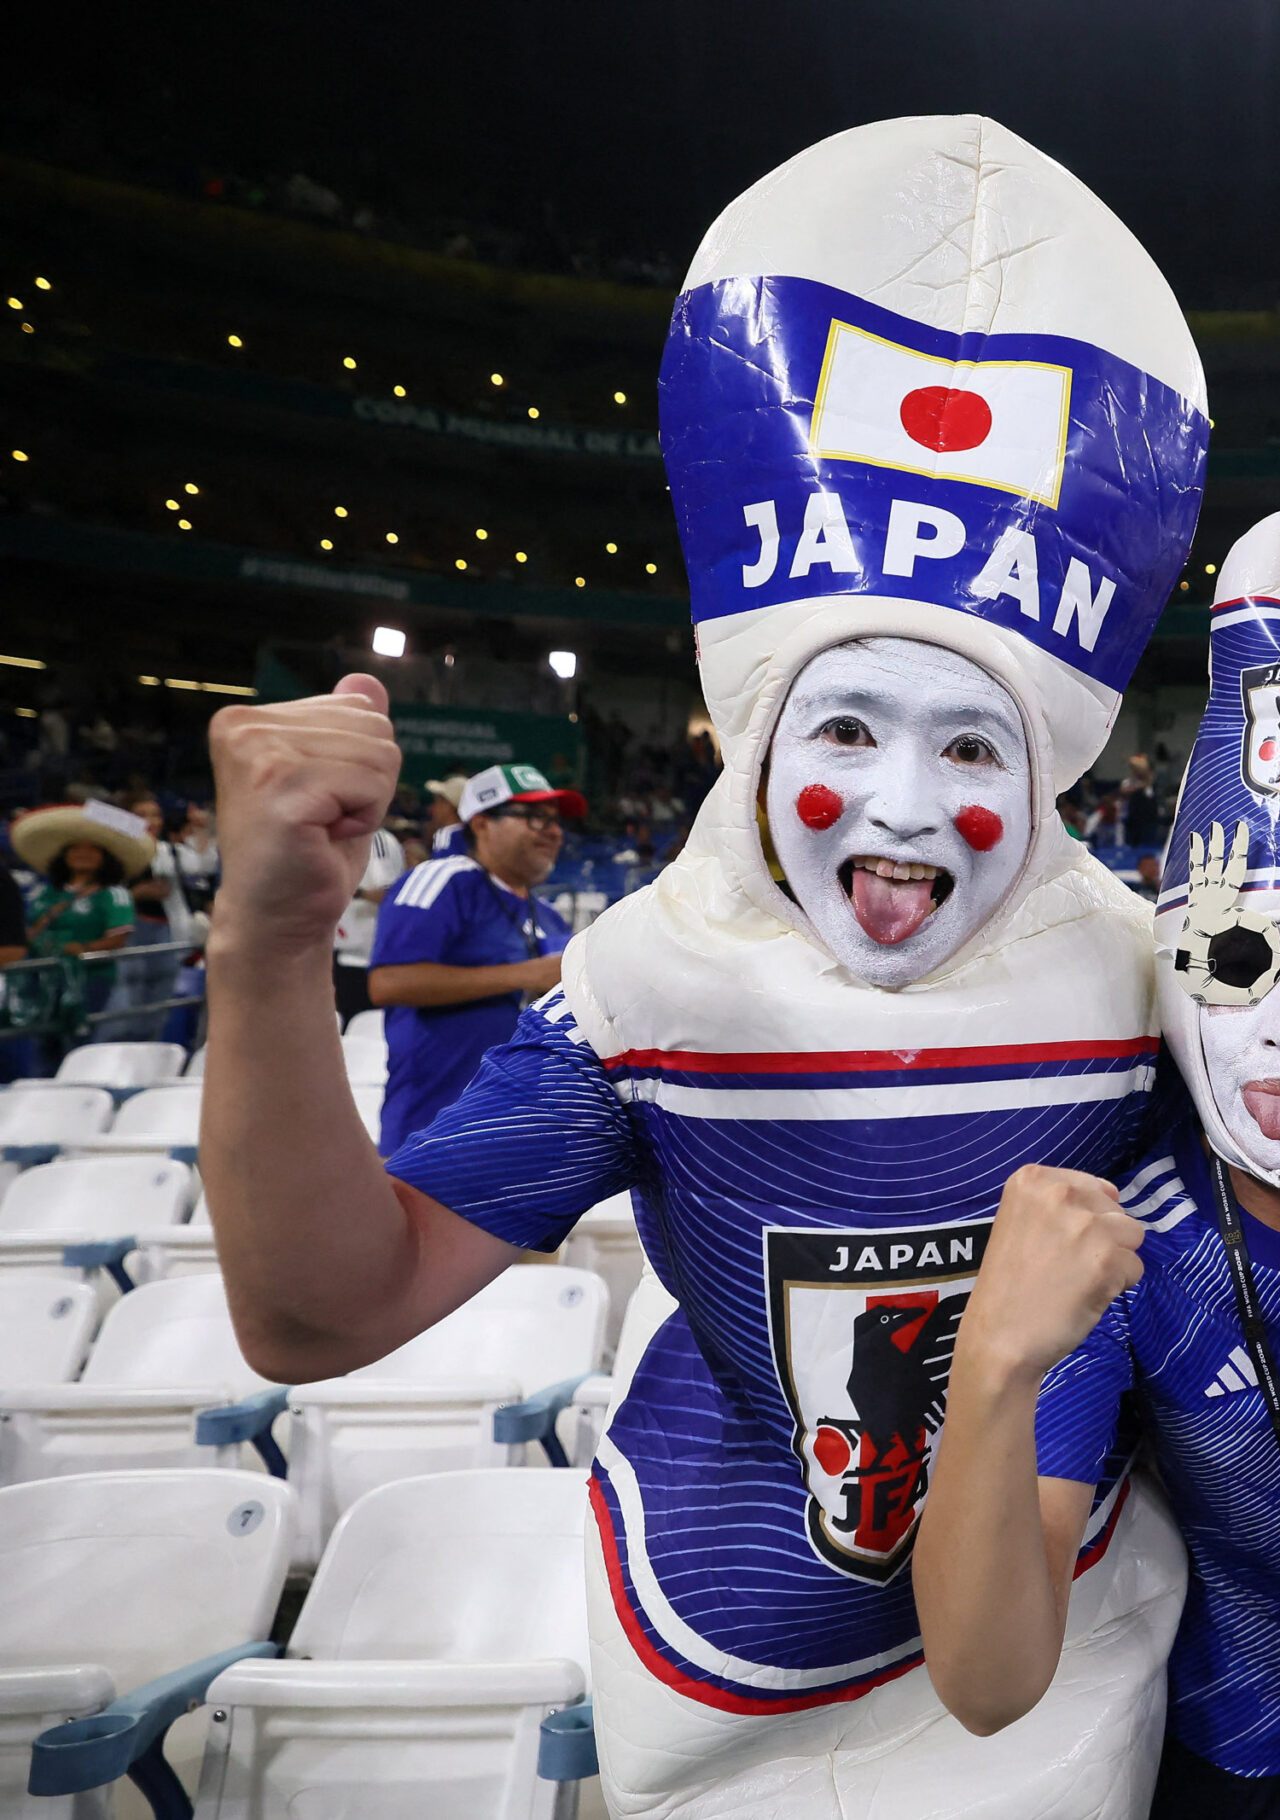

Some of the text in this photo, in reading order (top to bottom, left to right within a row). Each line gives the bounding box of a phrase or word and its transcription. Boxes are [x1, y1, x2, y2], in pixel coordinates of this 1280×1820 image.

[742, 492, 1117, 653] JAPAN
[829, 1237, 974, 1272] JAPAN
[1241, 1283, 1250, 1304] WORLD
[1266, 1375, 1277, 1397] WORLD
[831, 1456, 930, 1533] JFA
[240, 1508, 254, 1527] 7
